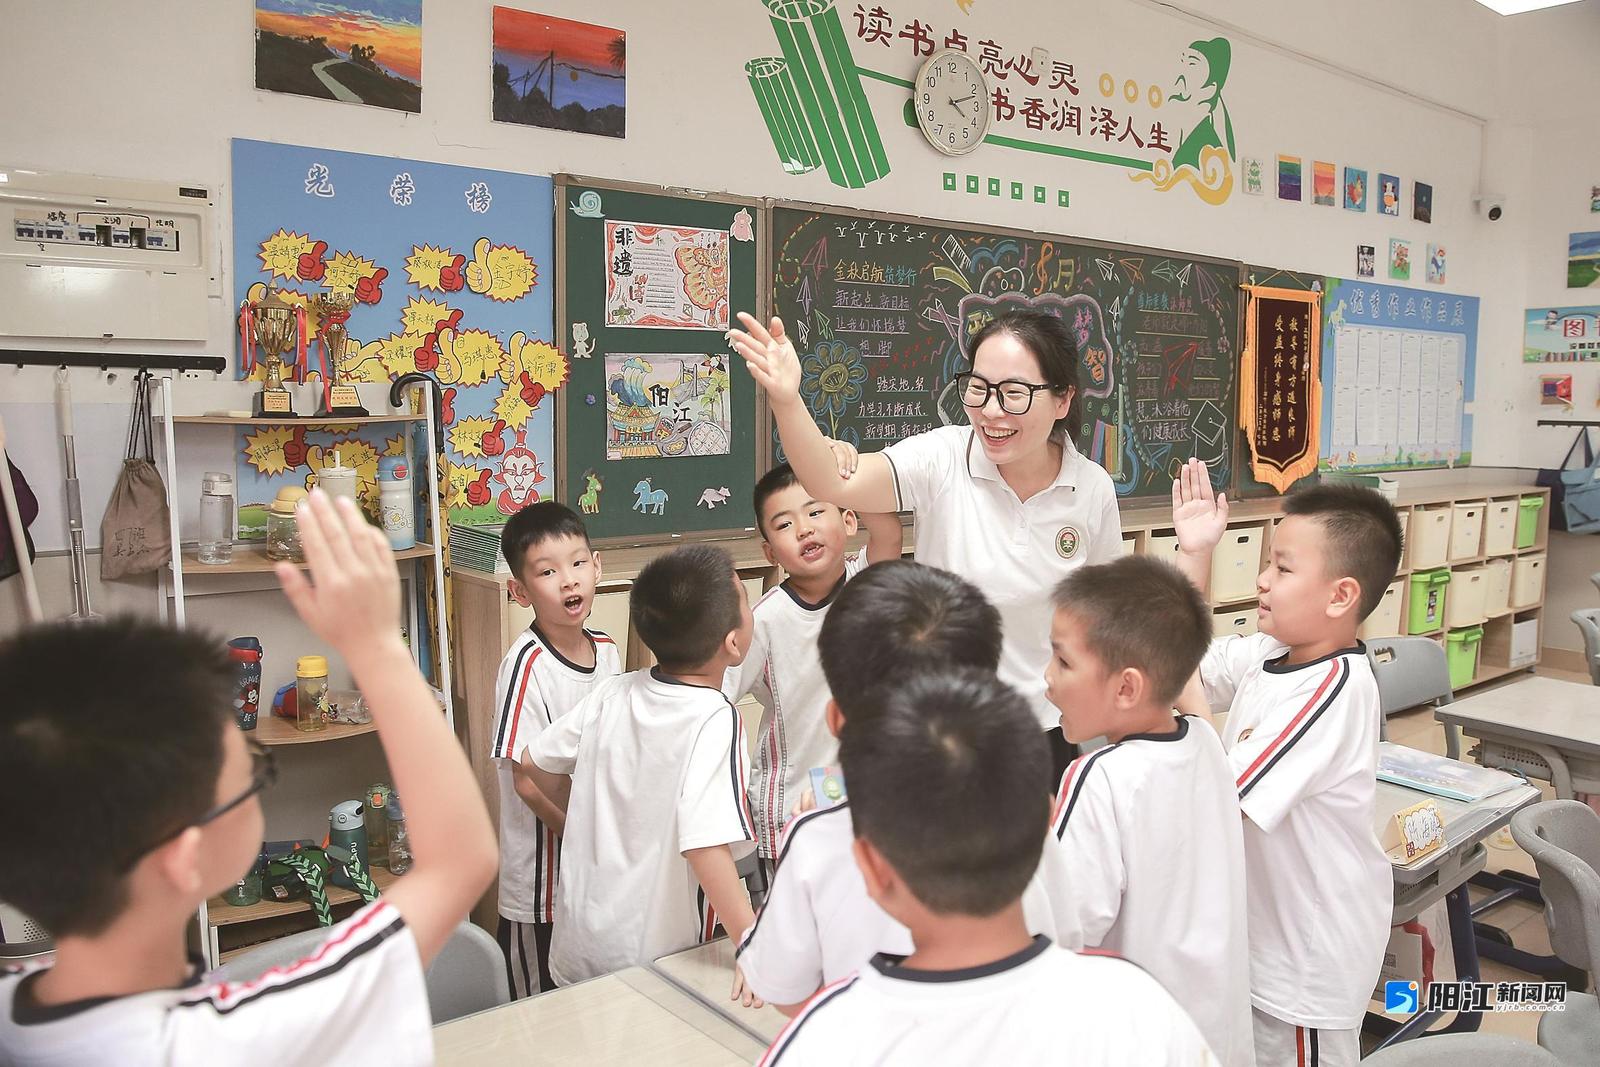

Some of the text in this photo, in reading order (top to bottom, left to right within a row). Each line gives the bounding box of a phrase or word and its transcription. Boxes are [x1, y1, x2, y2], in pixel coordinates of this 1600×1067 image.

[935, 66, 942, 78] 11
[947, 62, 957, 74] 12
[926, 76, 936, 88] 10
[971, 83, 977, 95] 2
[923, 93, 930, 105] 9
[973, 101, 980, 112] 3
[927, 110, 935, 122] 8
[990, 86, 1173, 154] 书香润泽人生
[971, 117, 977, 128] 4
[937, 124, 944, 135] 7
[962, 127, 969, 139] 5
[948, 132, 956, 144] 6
[304, 163, 493, 215] 光荣榜
[613, 227, 635, 277] 非遗
[648, 383, 692, 424] 阳江
